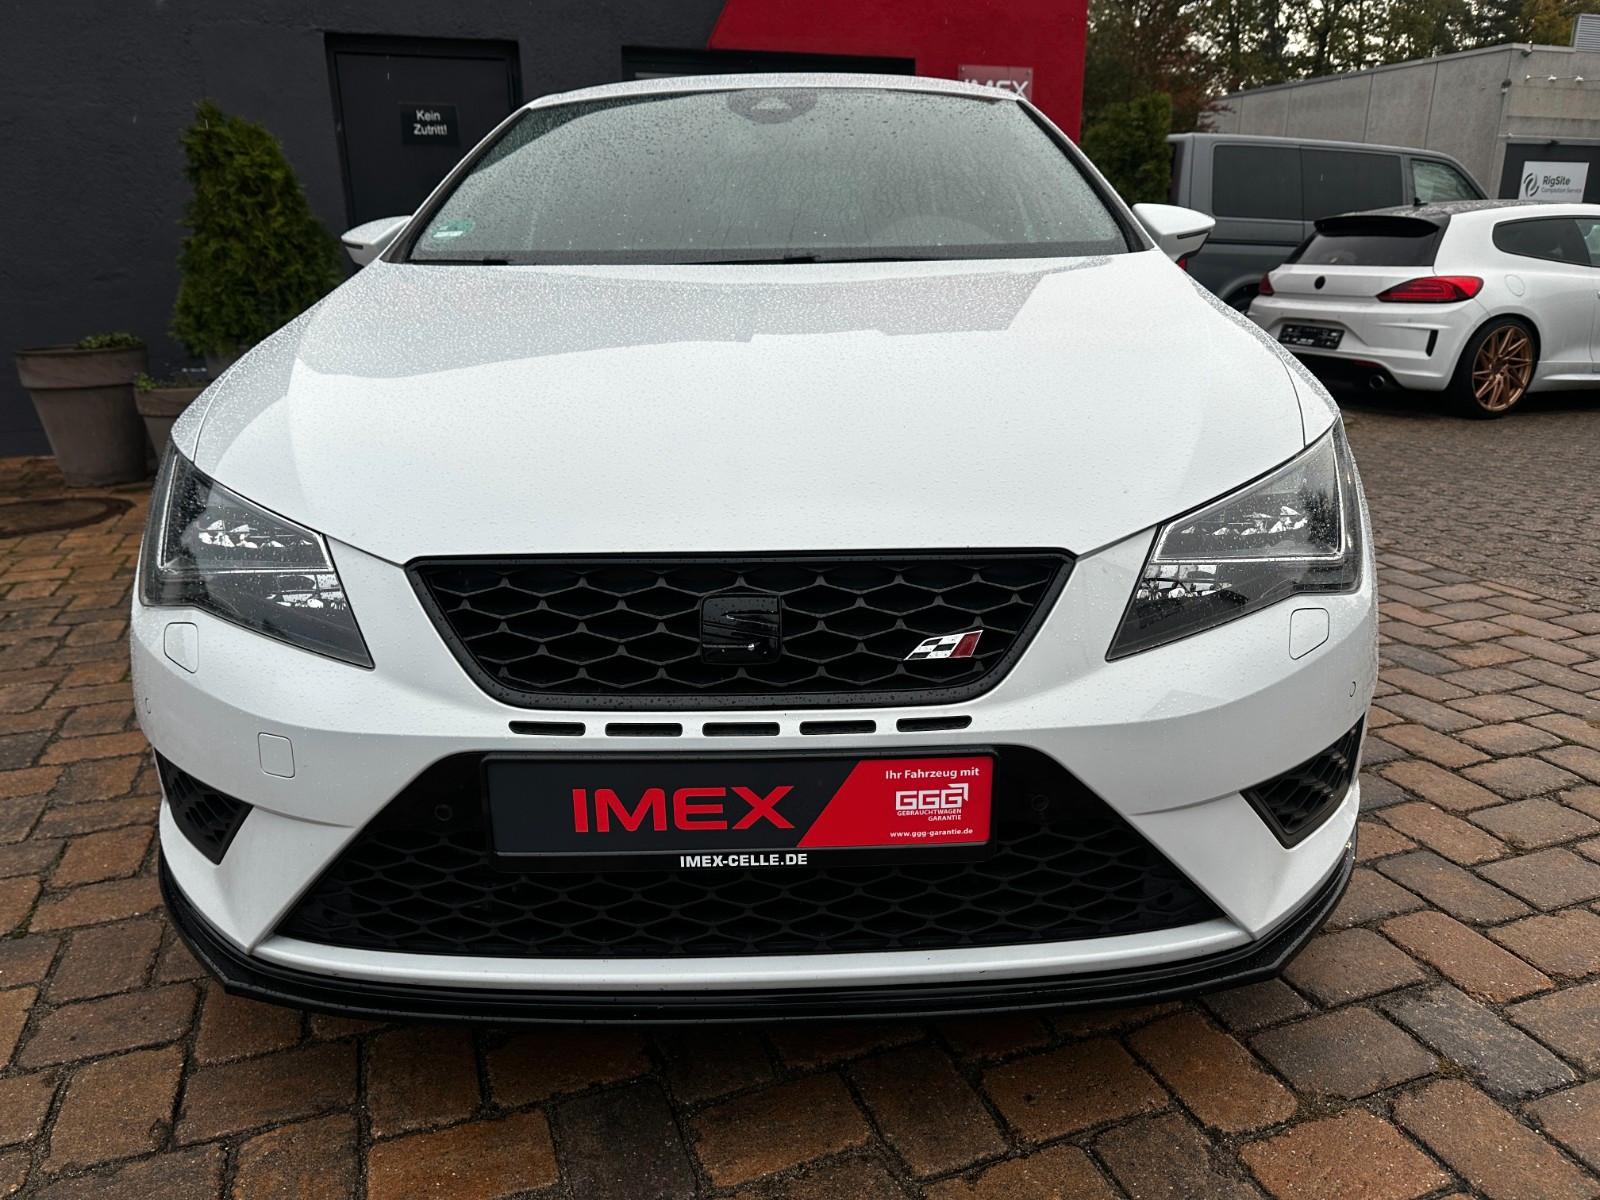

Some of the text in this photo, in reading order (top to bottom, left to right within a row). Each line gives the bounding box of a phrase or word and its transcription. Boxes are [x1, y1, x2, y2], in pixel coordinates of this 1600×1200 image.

[415, 109, 441, 121] Kein
[413, 123, 448, 135] Zutritt!
[1542, 175, 1571, 187] RigSite
[885, 766, 980, 780] Ihr Fahrzeug mit
[895, 788, 963, 811] GGG
[572, 785, 796, 833] IMEX
[896, 808, 962, 816] GEBRAUCHTWAGEN
[890, 827, 974, 838] www.ggg-garantie.de
[679, 853, 809, 868] IMEX-CELLE.DE
